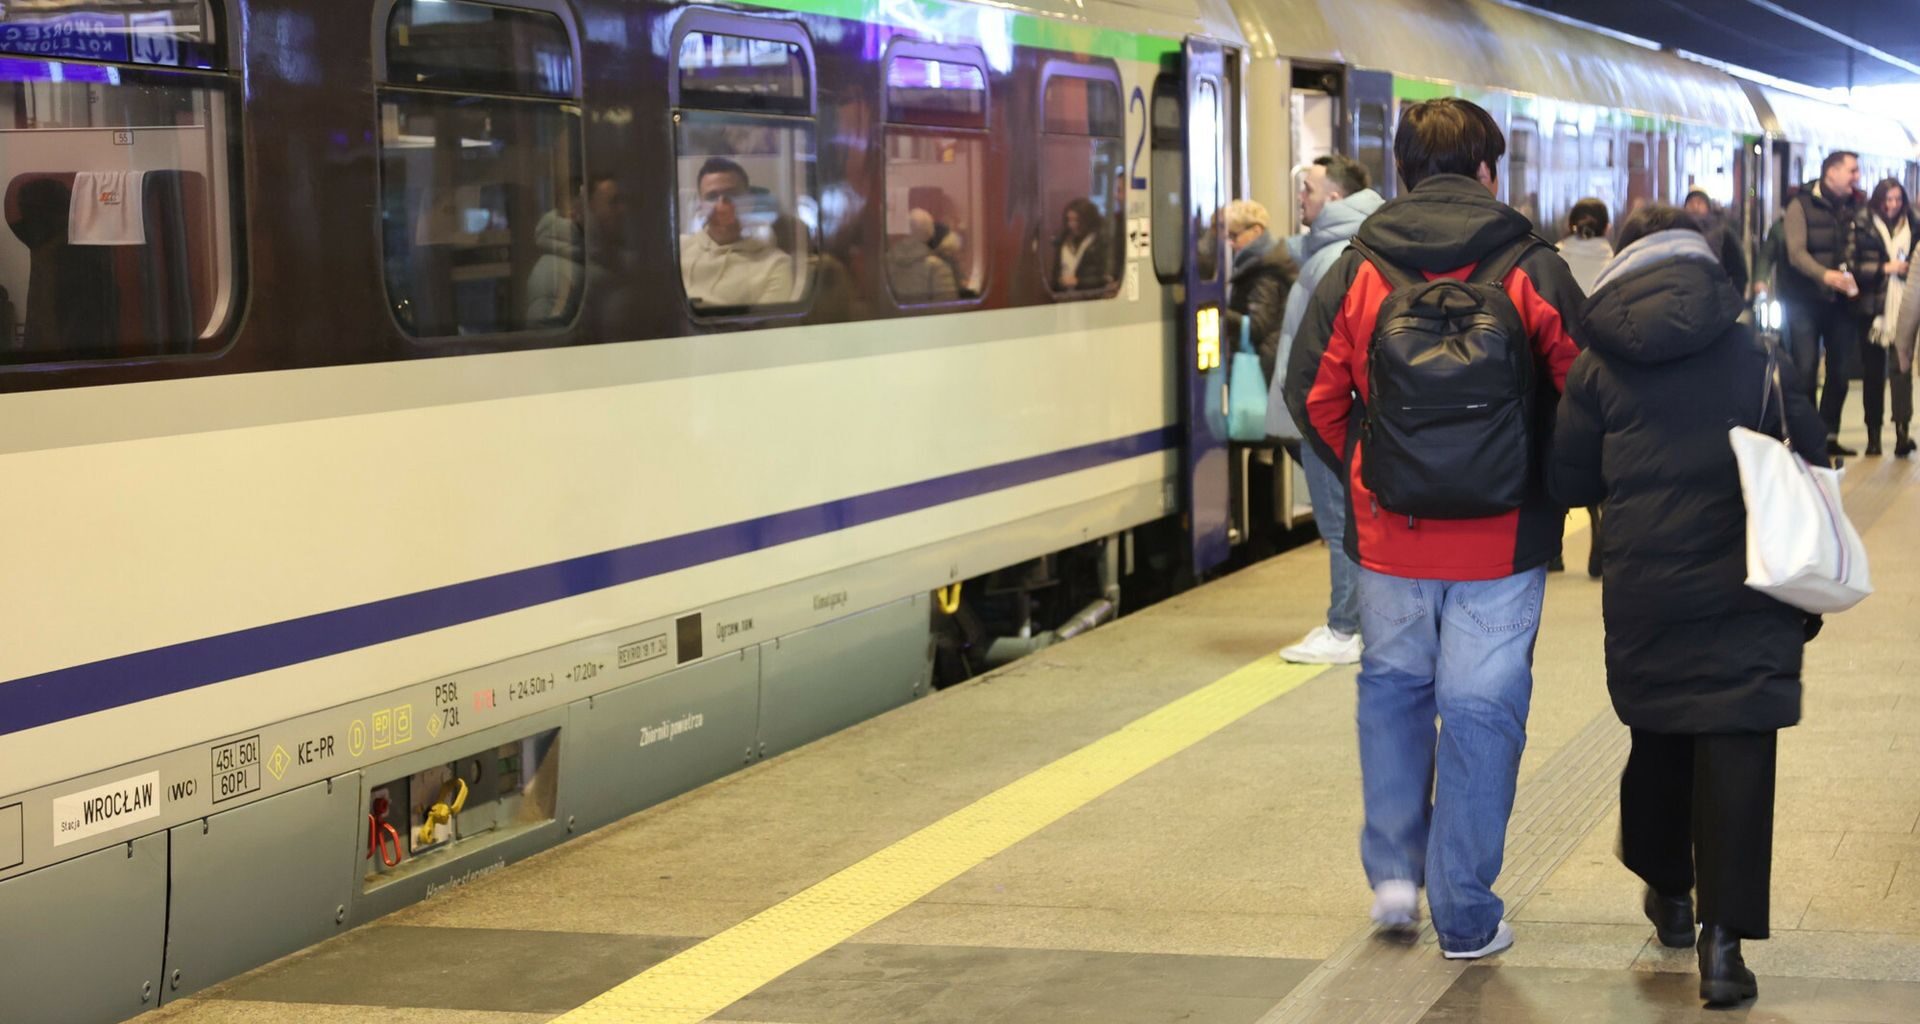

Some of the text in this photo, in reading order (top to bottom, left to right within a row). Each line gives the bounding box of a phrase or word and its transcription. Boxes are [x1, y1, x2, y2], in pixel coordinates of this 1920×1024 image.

[119, 133, 128, 143] 55
[1129, 86, 1147, 189] 2
[435, 681, 458, 706] P56t
[442, 706, 459, 729] 73t
[670, 712, 703, 741] powietrza
[216, 742, 257, 771] 45t 50t
[298, 735, 335, 766] KE-PR
[168, 779, 197, 803] (WC)
[61, 782, 153, 832] Stacja WROCŁAW
